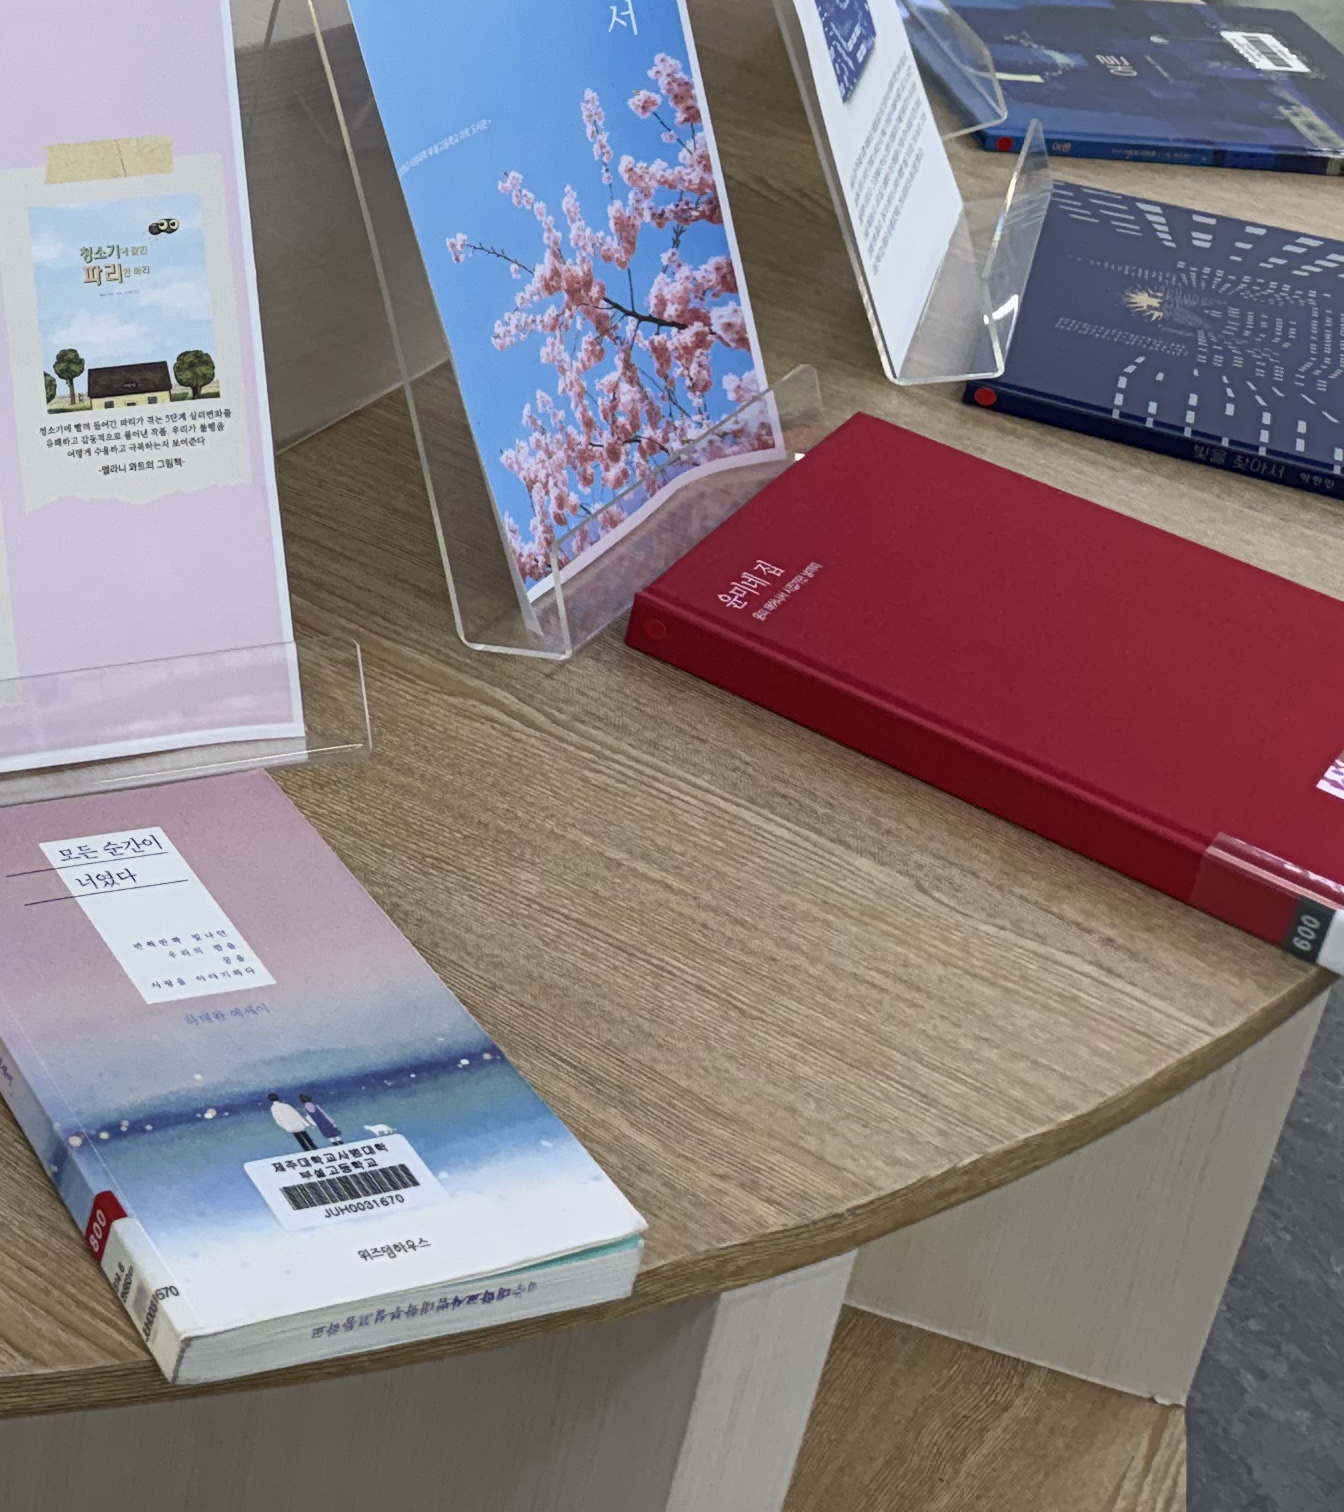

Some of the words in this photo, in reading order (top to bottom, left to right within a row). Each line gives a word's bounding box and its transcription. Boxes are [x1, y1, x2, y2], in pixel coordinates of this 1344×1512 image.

[1231, 454, 1285, 479] 찾아서
[717, 572, 771, 609] 윤미네
[753, 559, 785, 577] 집
[58, 844, 98, 861] 모든
[103, 834, 162, 856] 순간이
[75, 868, 136, 889] 너였다
[1292, 913, 1322, 952] 600
[270, 1142, 388, 1172] 제주대학교사범대학
[299, 1157, 378, 1179] 부설고등학교
[324, 1193, 404, 1218] JUH0031670
[89, 1209, 107, 1252] 800
[357, 1237, 431, 1261] 위즈덤하우스
